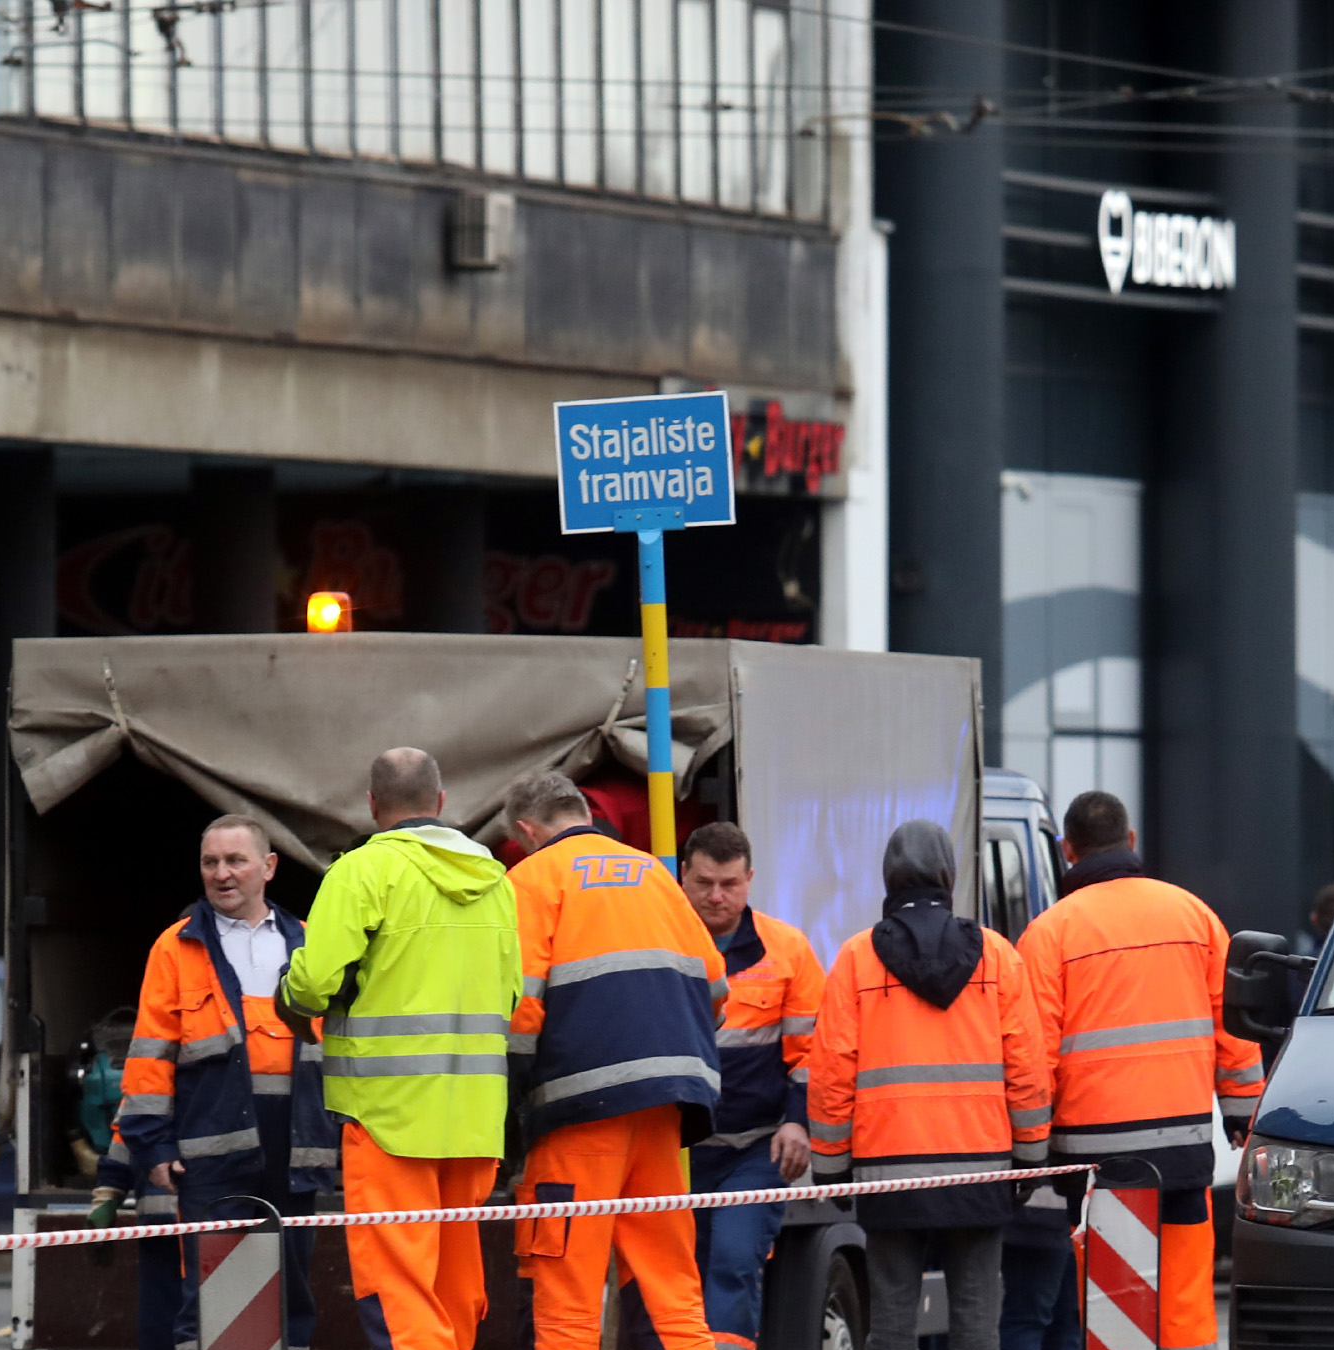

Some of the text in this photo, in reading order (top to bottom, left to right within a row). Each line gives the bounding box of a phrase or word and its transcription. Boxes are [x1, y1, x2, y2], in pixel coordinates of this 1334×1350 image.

[569, 416, 715, 466] Stajalište
[578, 460, 714, 504] tramvaja
[571, 854, 653, 890] ZET
